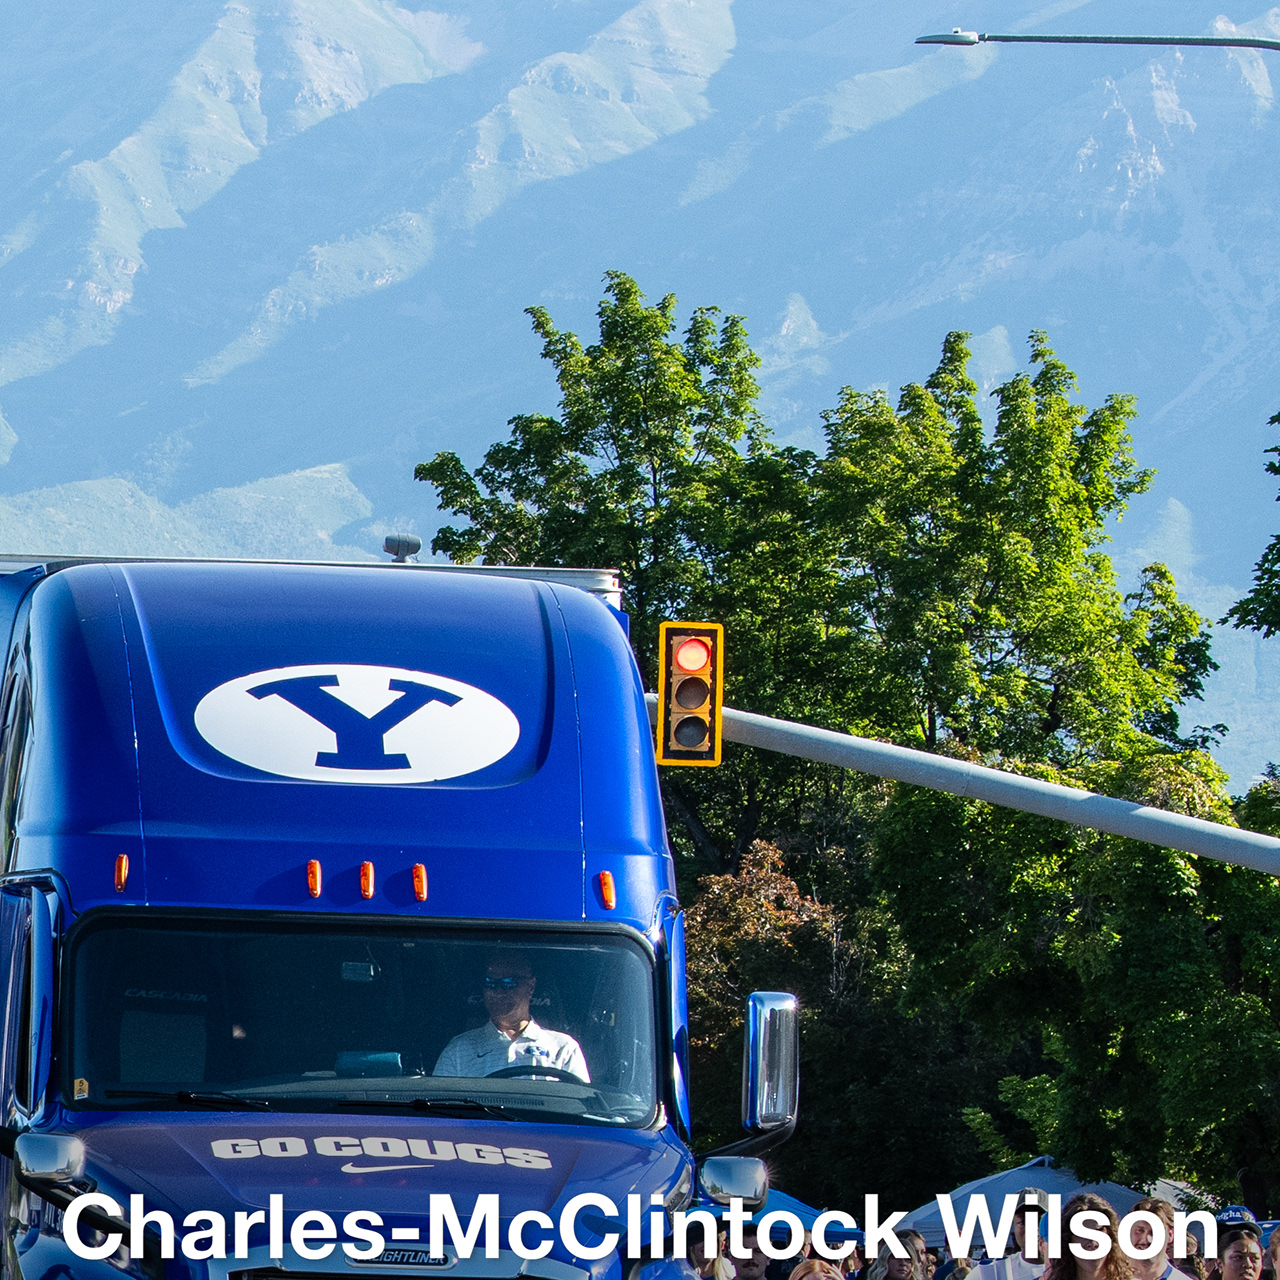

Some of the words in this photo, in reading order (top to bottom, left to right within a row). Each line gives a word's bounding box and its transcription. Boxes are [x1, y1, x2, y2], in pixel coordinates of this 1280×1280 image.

[245, 675, 463, 771] Y
[125, 988, 207, 1002] CASCADIA
[211, 1138, 309, 1159] GO
[313, 1136, 553, 1169] COUGS
